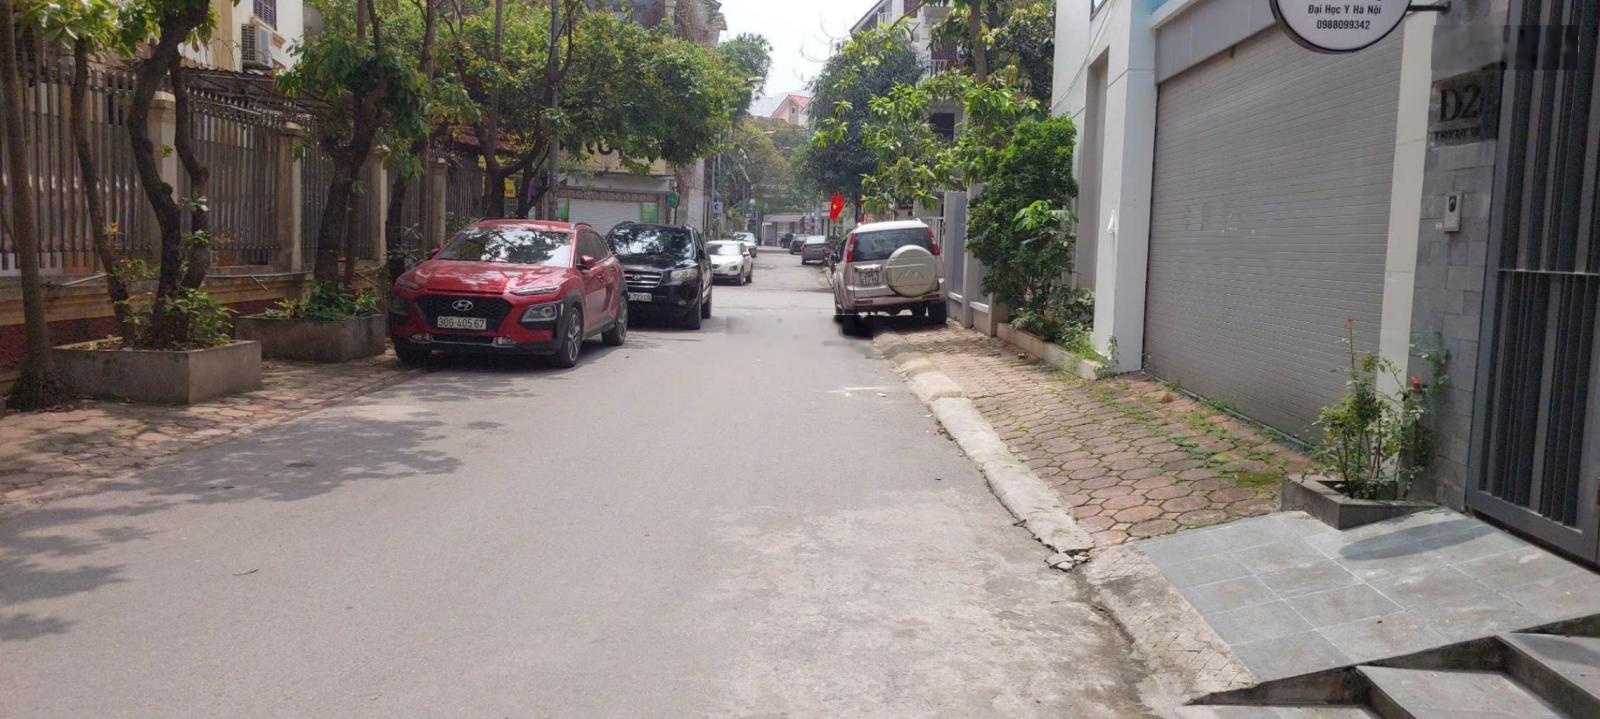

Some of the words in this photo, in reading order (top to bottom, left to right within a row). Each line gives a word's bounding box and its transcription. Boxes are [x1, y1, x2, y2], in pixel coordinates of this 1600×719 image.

[1308, 4, 1322, 15] Đại
[1325, 5, 1341, 15] Học
[1344, 5, 1350, 14] Y
[1316, 19, 1371, 30] 0988099342
